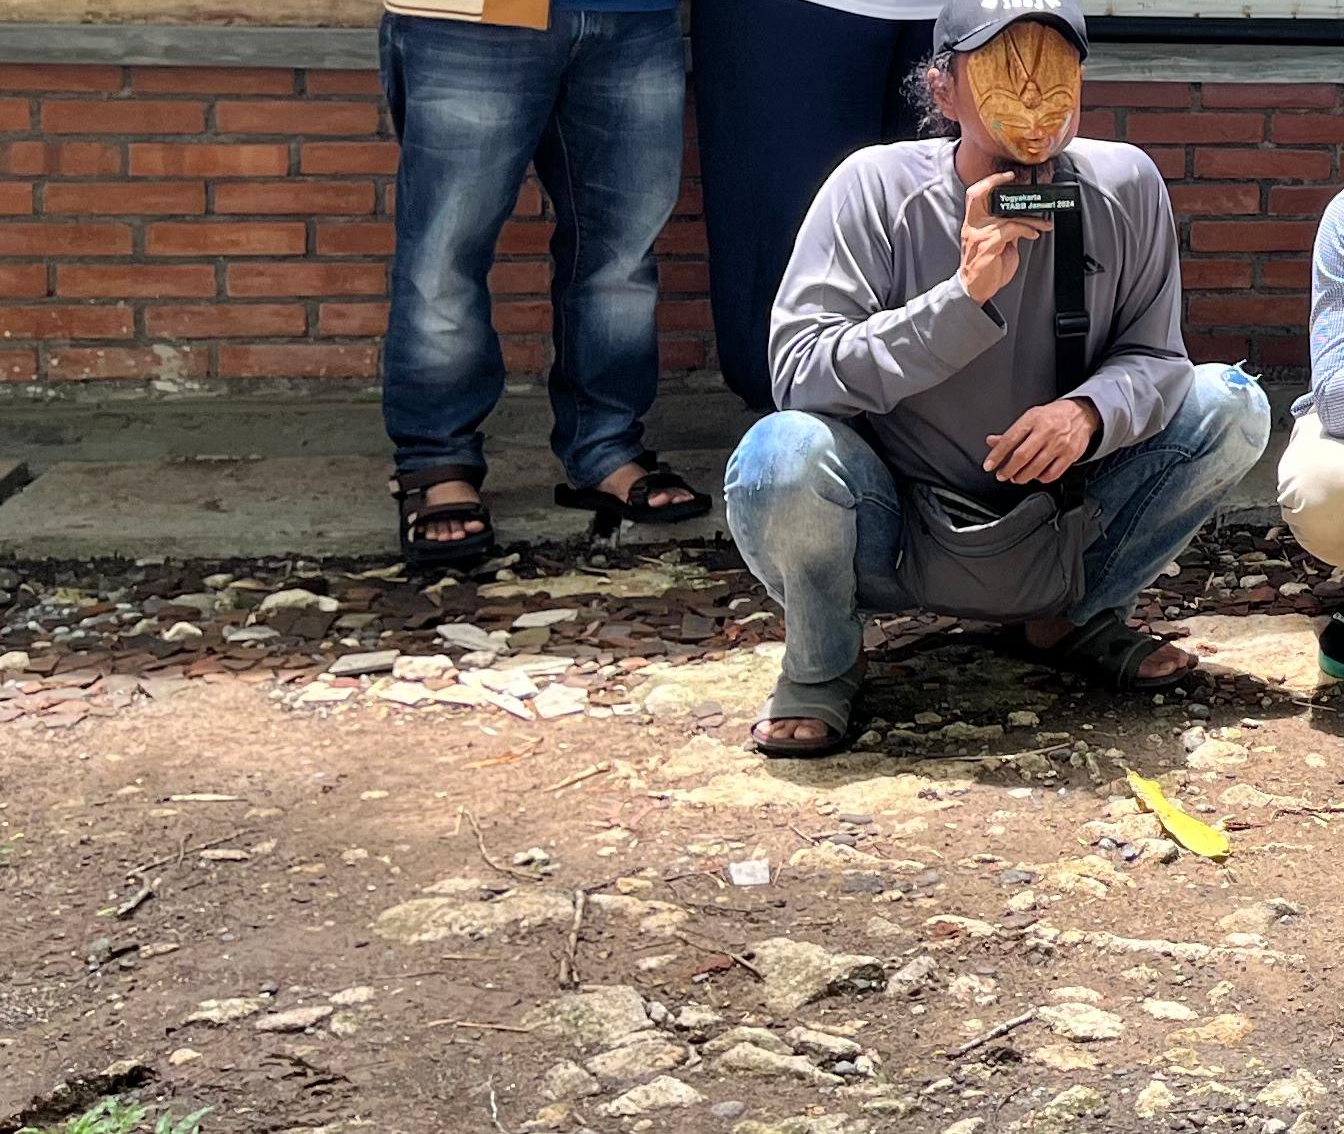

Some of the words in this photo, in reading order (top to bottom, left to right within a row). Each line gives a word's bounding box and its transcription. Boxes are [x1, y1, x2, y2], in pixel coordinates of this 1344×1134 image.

[1000, 194, 1041, 203] Yogyakarta
[1028, 201, 1055, 209] Januari
[1057, 199, 1075, 208] 2024
